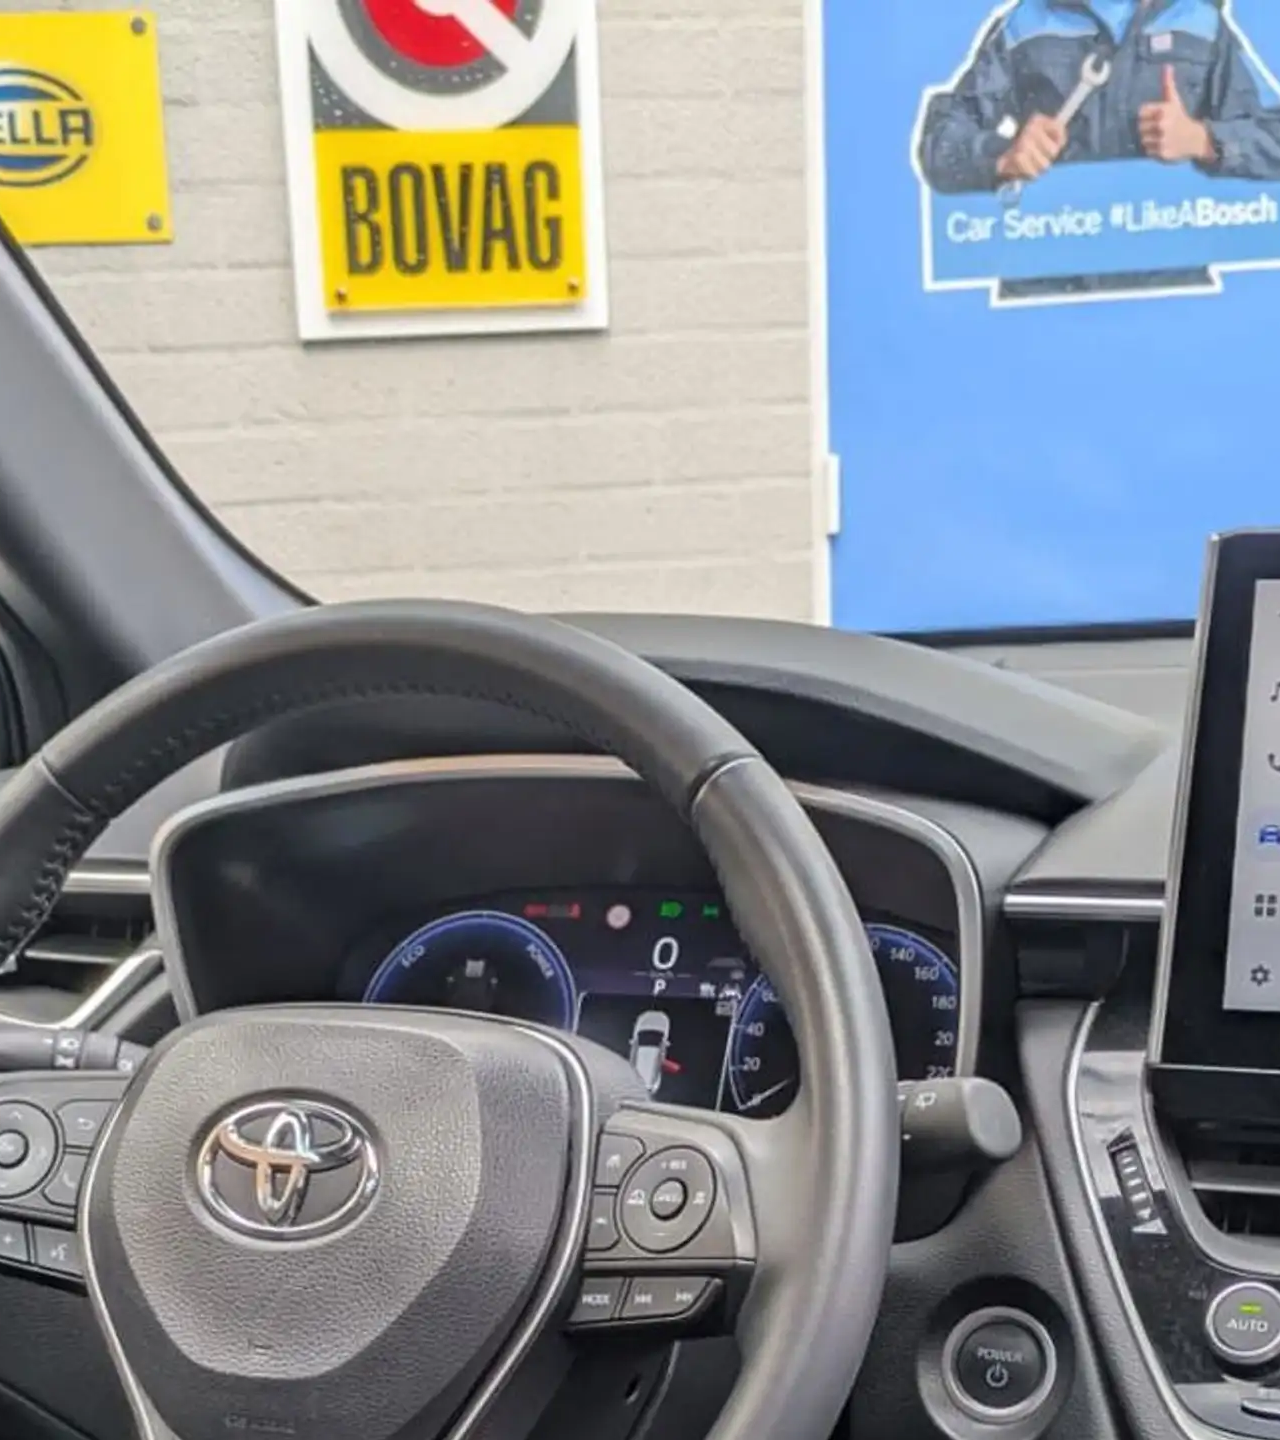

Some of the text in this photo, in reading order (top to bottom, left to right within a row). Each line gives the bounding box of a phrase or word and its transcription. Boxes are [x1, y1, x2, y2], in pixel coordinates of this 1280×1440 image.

[340, 159, 564, 276] BOVAG
[946, 192, 1278, 243] Car Service #LikeABosch
[652, 936, 679, 970] 0
[654, 979, 667, 996] P
[747, 1021, 765, 1036] 40
[743, 1056, 761, 1071] 20
[1225, 1318, 1268, 1333] AUTO
